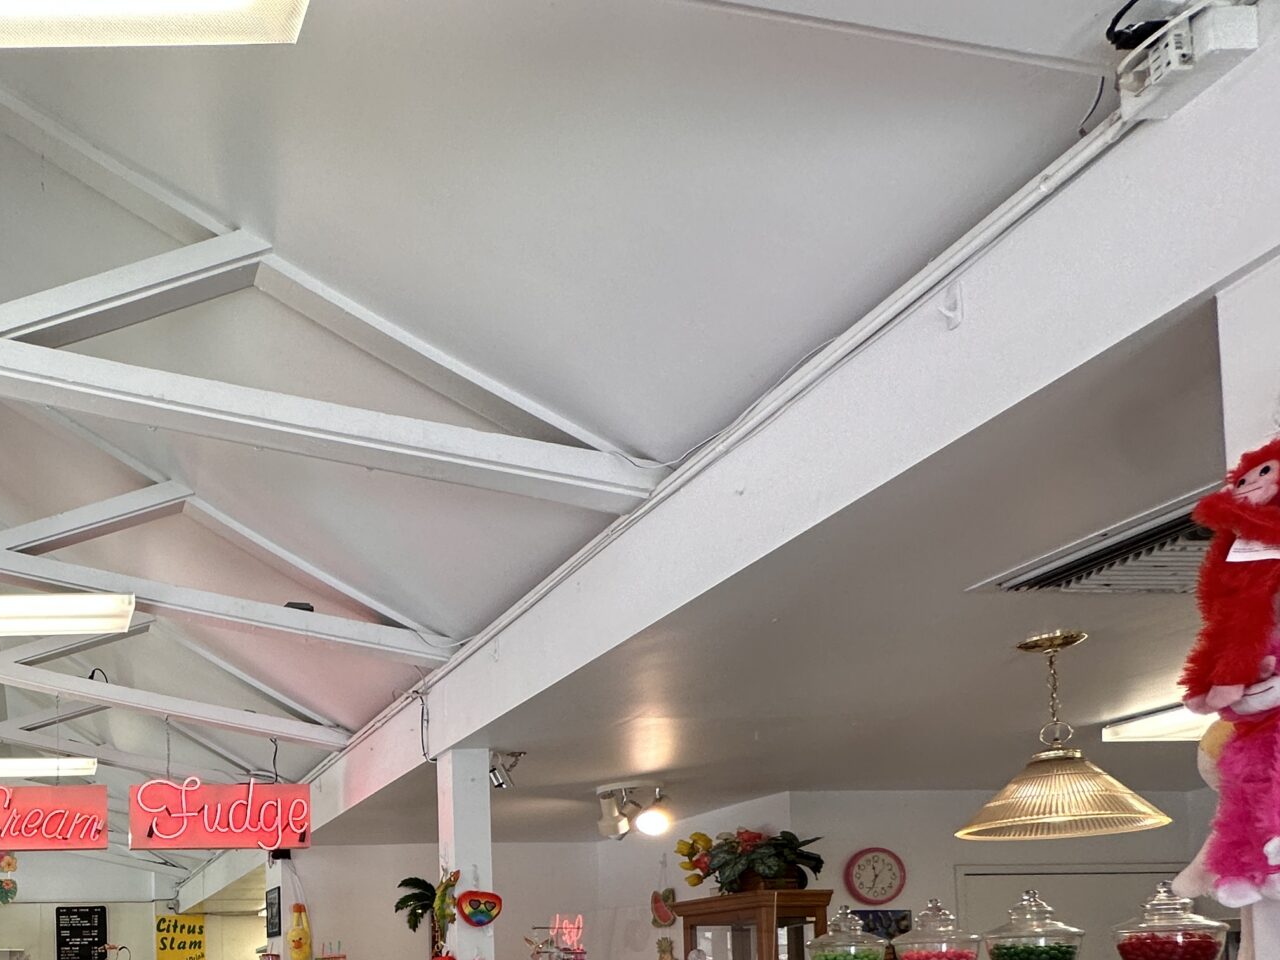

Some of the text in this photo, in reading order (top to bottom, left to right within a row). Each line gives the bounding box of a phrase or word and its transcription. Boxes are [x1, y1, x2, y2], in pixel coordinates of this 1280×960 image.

[137, 776, 308, 850] Fudge
[156, 917, 205, 934] Citrus
[159, 937, 202, 951] Slam
